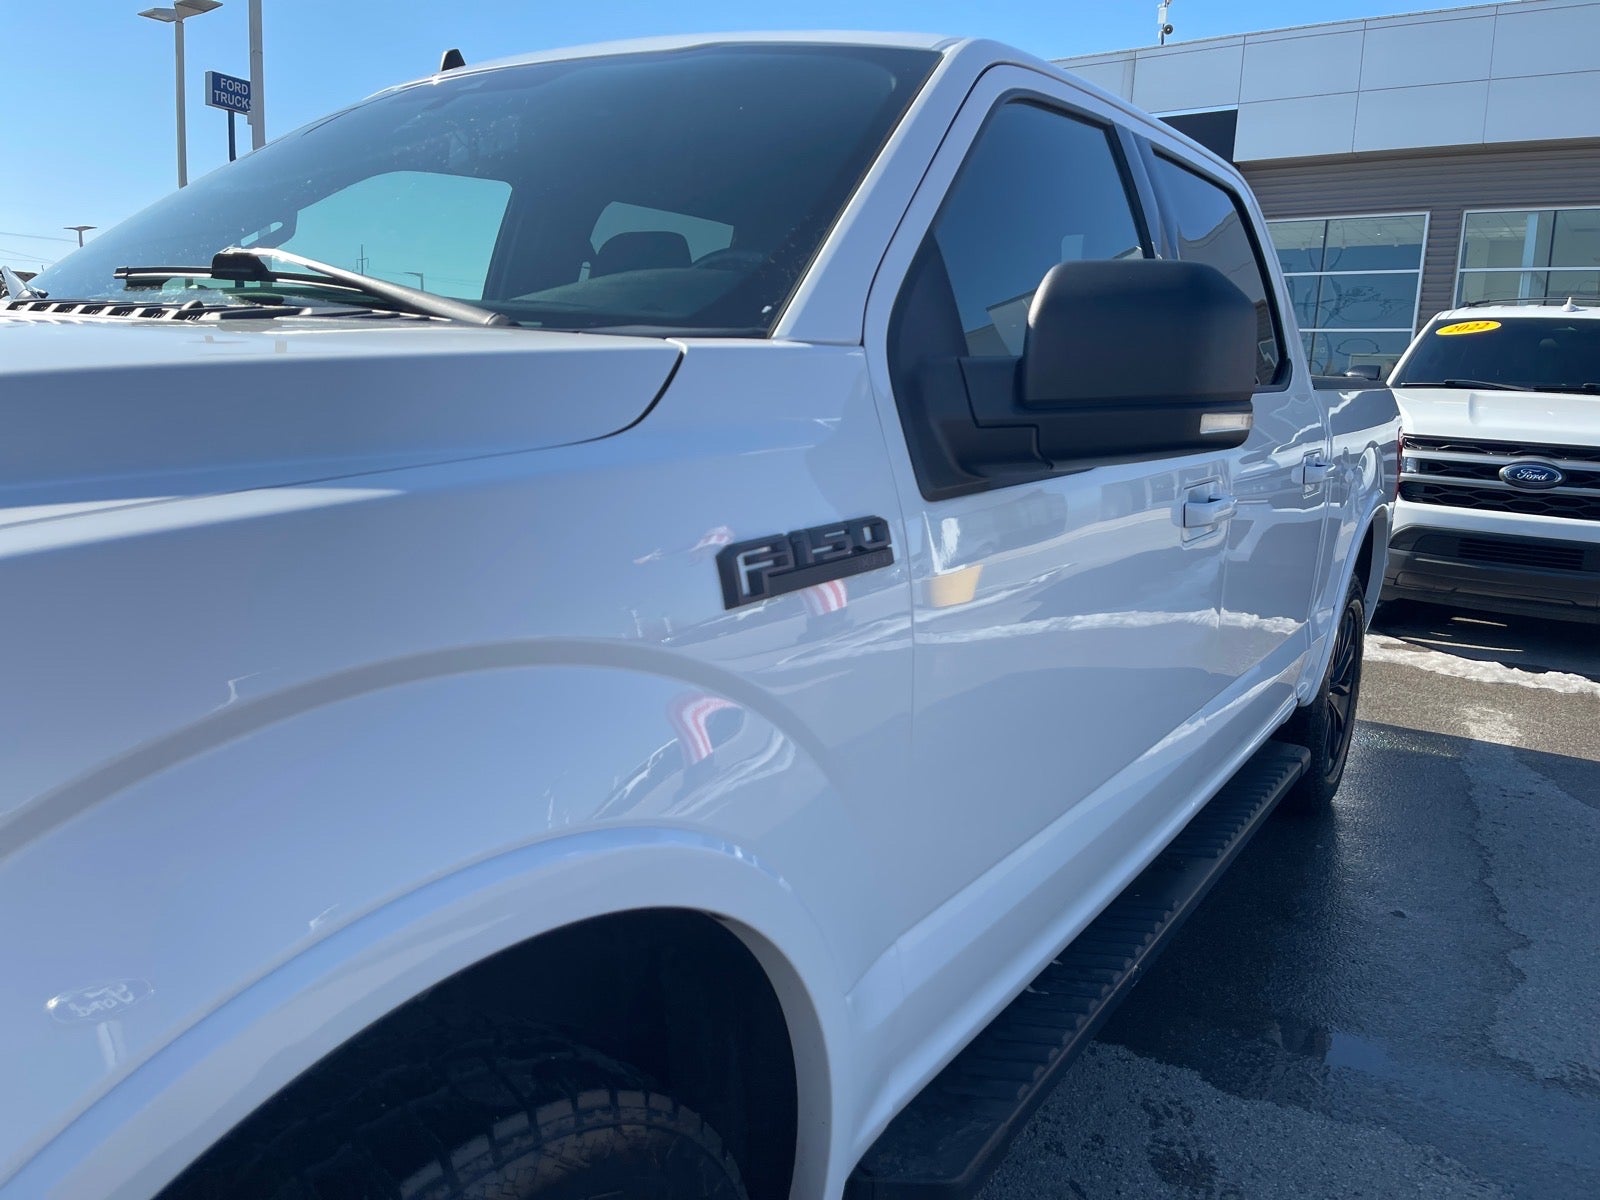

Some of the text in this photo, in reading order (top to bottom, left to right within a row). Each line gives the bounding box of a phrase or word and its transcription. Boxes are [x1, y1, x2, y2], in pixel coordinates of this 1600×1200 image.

[220, 77, 249, 95] FORD
[1444, 322, 1490, 333] 2022
[1516, 468, 1548, 481] Ford
